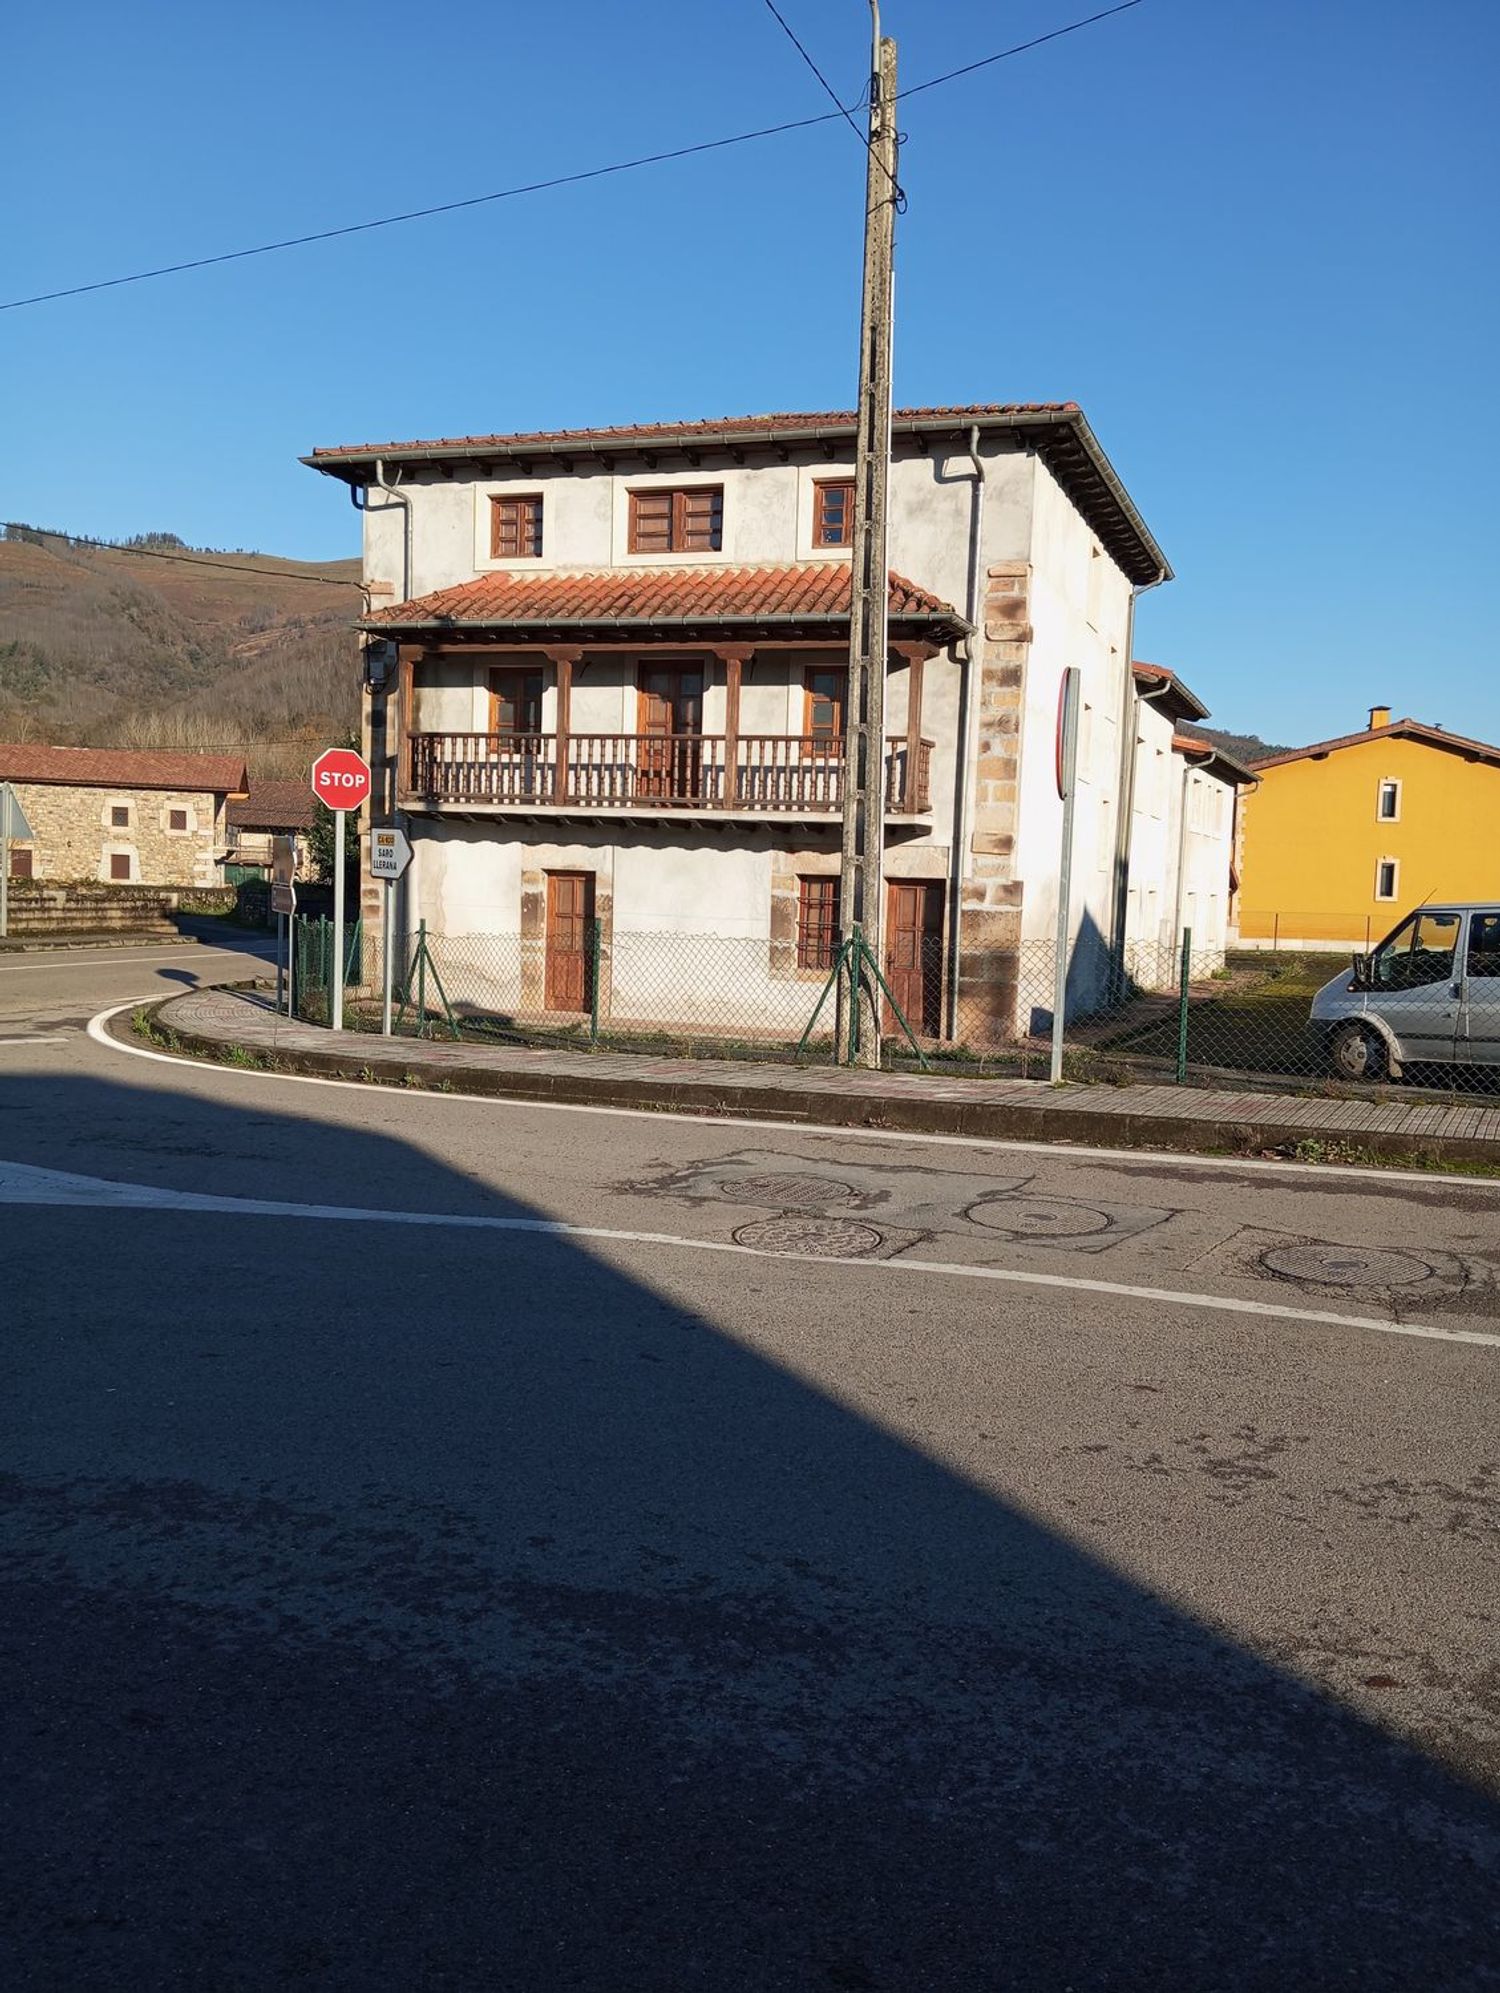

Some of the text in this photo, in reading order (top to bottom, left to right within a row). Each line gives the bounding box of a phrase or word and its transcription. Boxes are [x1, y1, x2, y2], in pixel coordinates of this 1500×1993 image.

[320, 771, 365, 788] STOP
[378, 848, 393, 858] SARO
[373, 860, 397, 870] LLERANA
